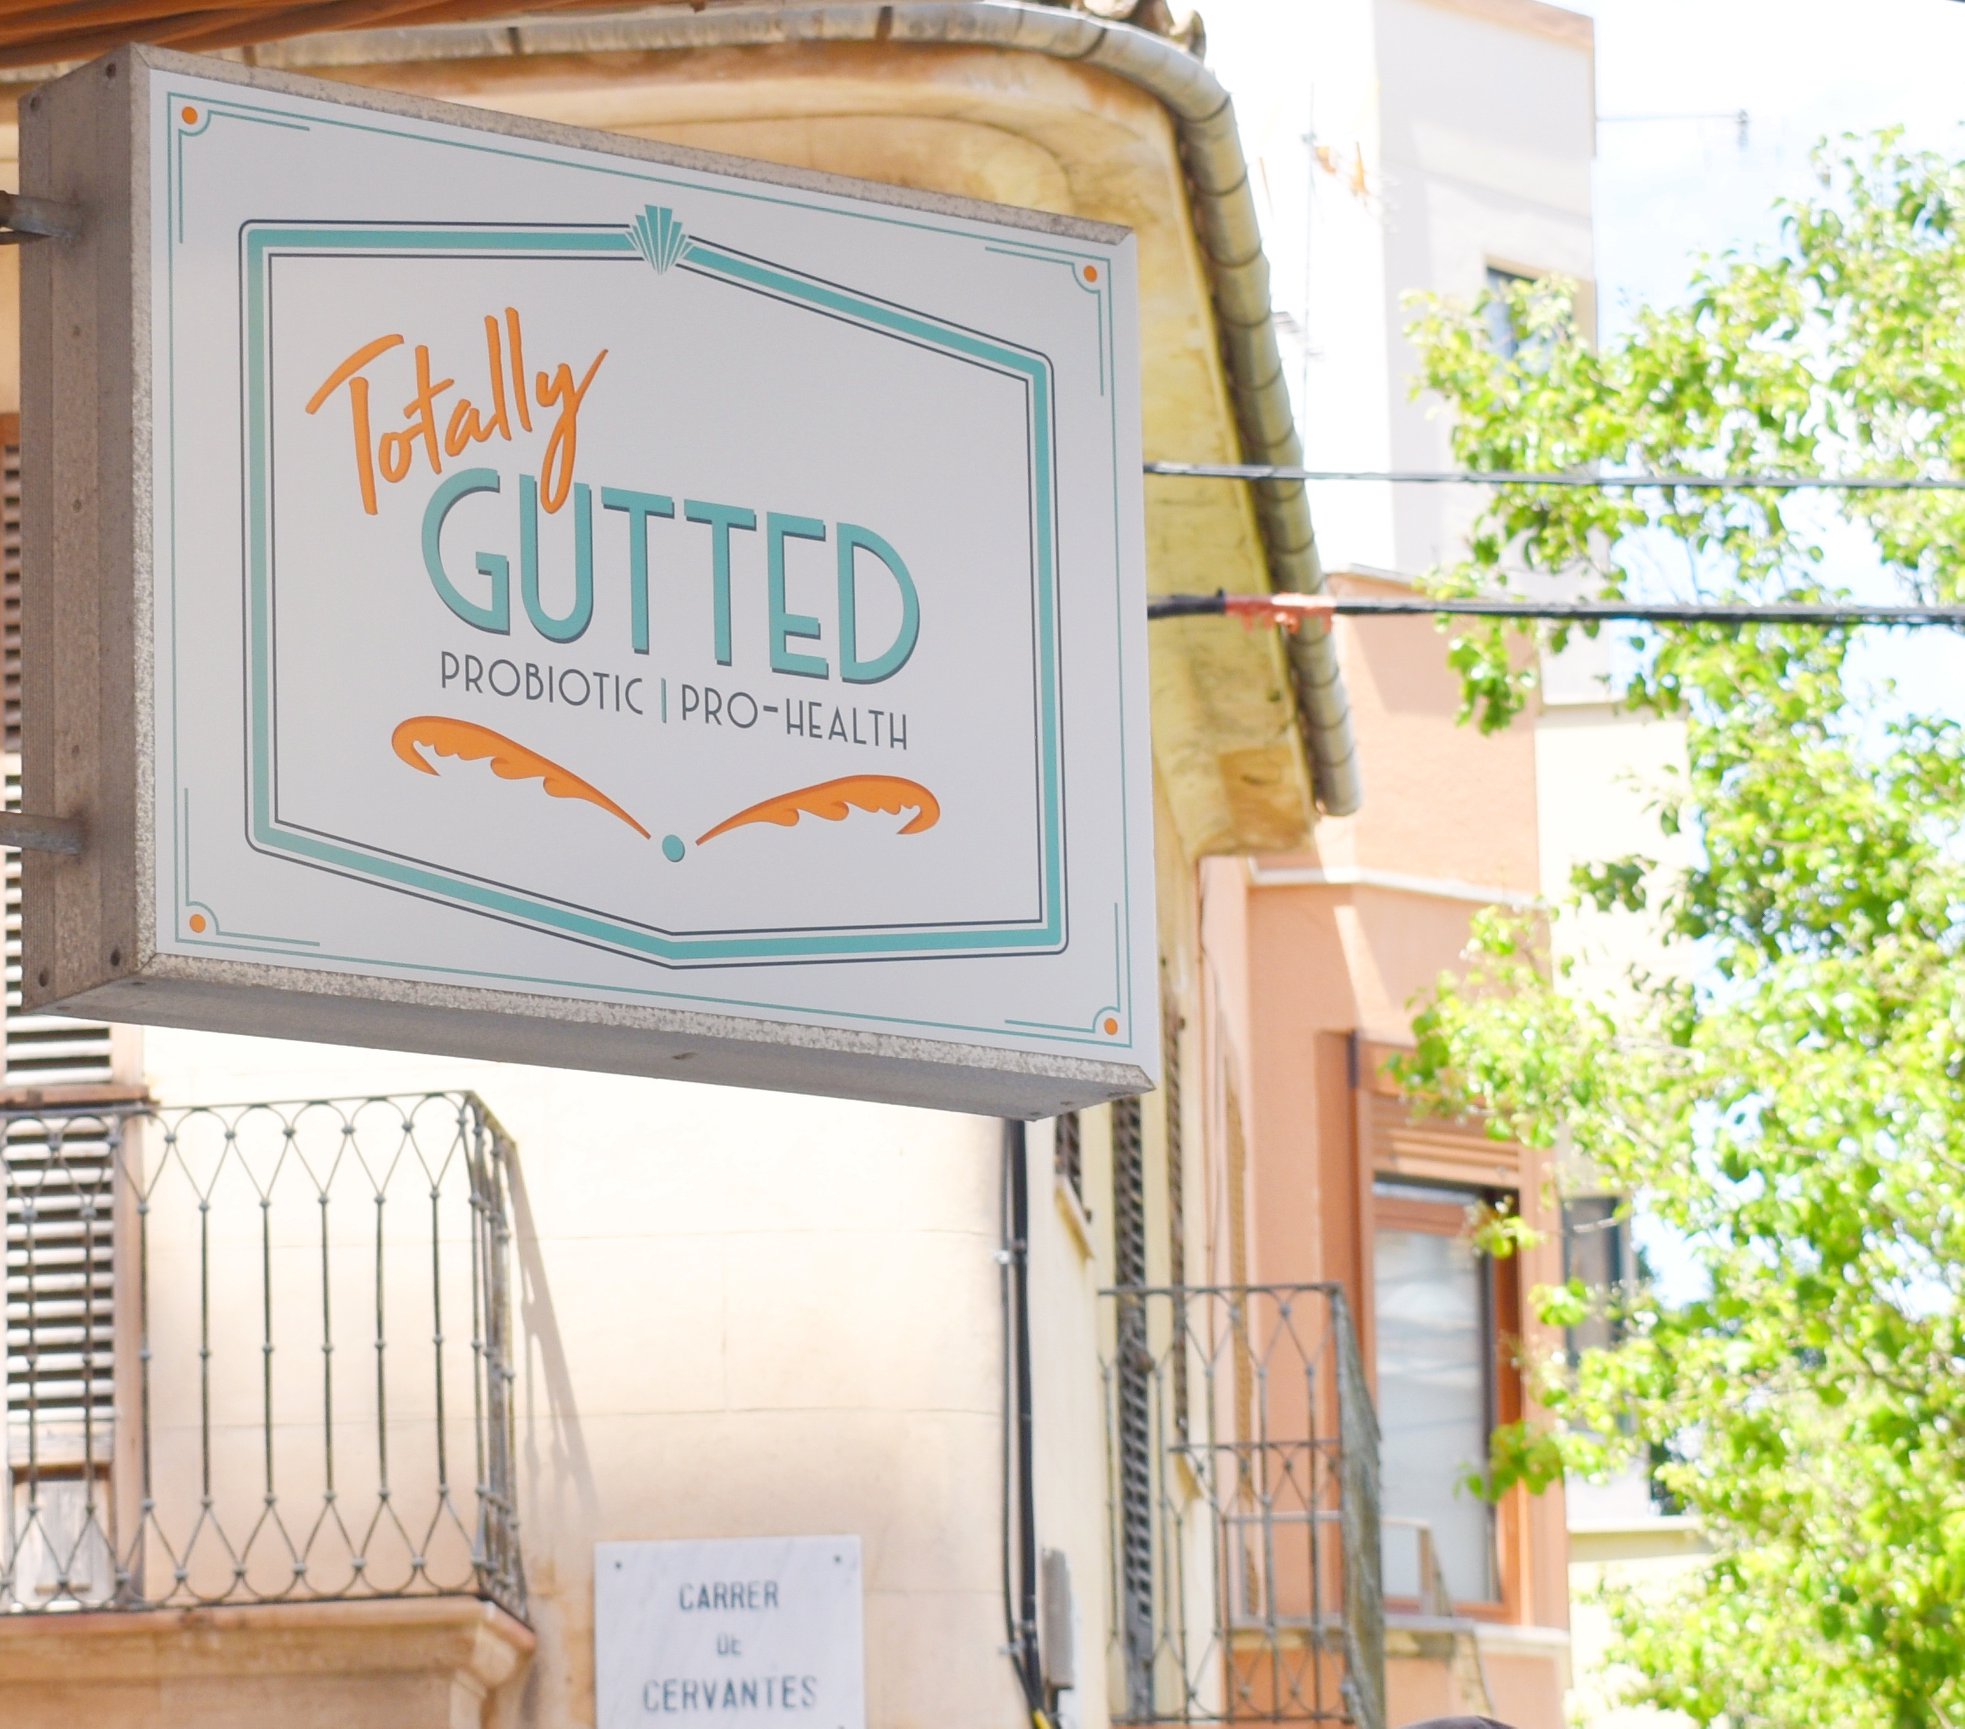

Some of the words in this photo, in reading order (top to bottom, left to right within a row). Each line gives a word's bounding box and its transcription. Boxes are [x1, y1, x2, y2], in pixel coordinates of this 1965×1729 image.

[305, 306, 609, 516] Totally
[421, 467, 921, 685] GUTTED
[440, 650, 644, 716] PROBIOTIC
[681, 683, 908, 751] PRO-HEALTH
[679, 1581, 780, 1611] CARRER
[643, 1676, 818, 1712] CERVANTES
